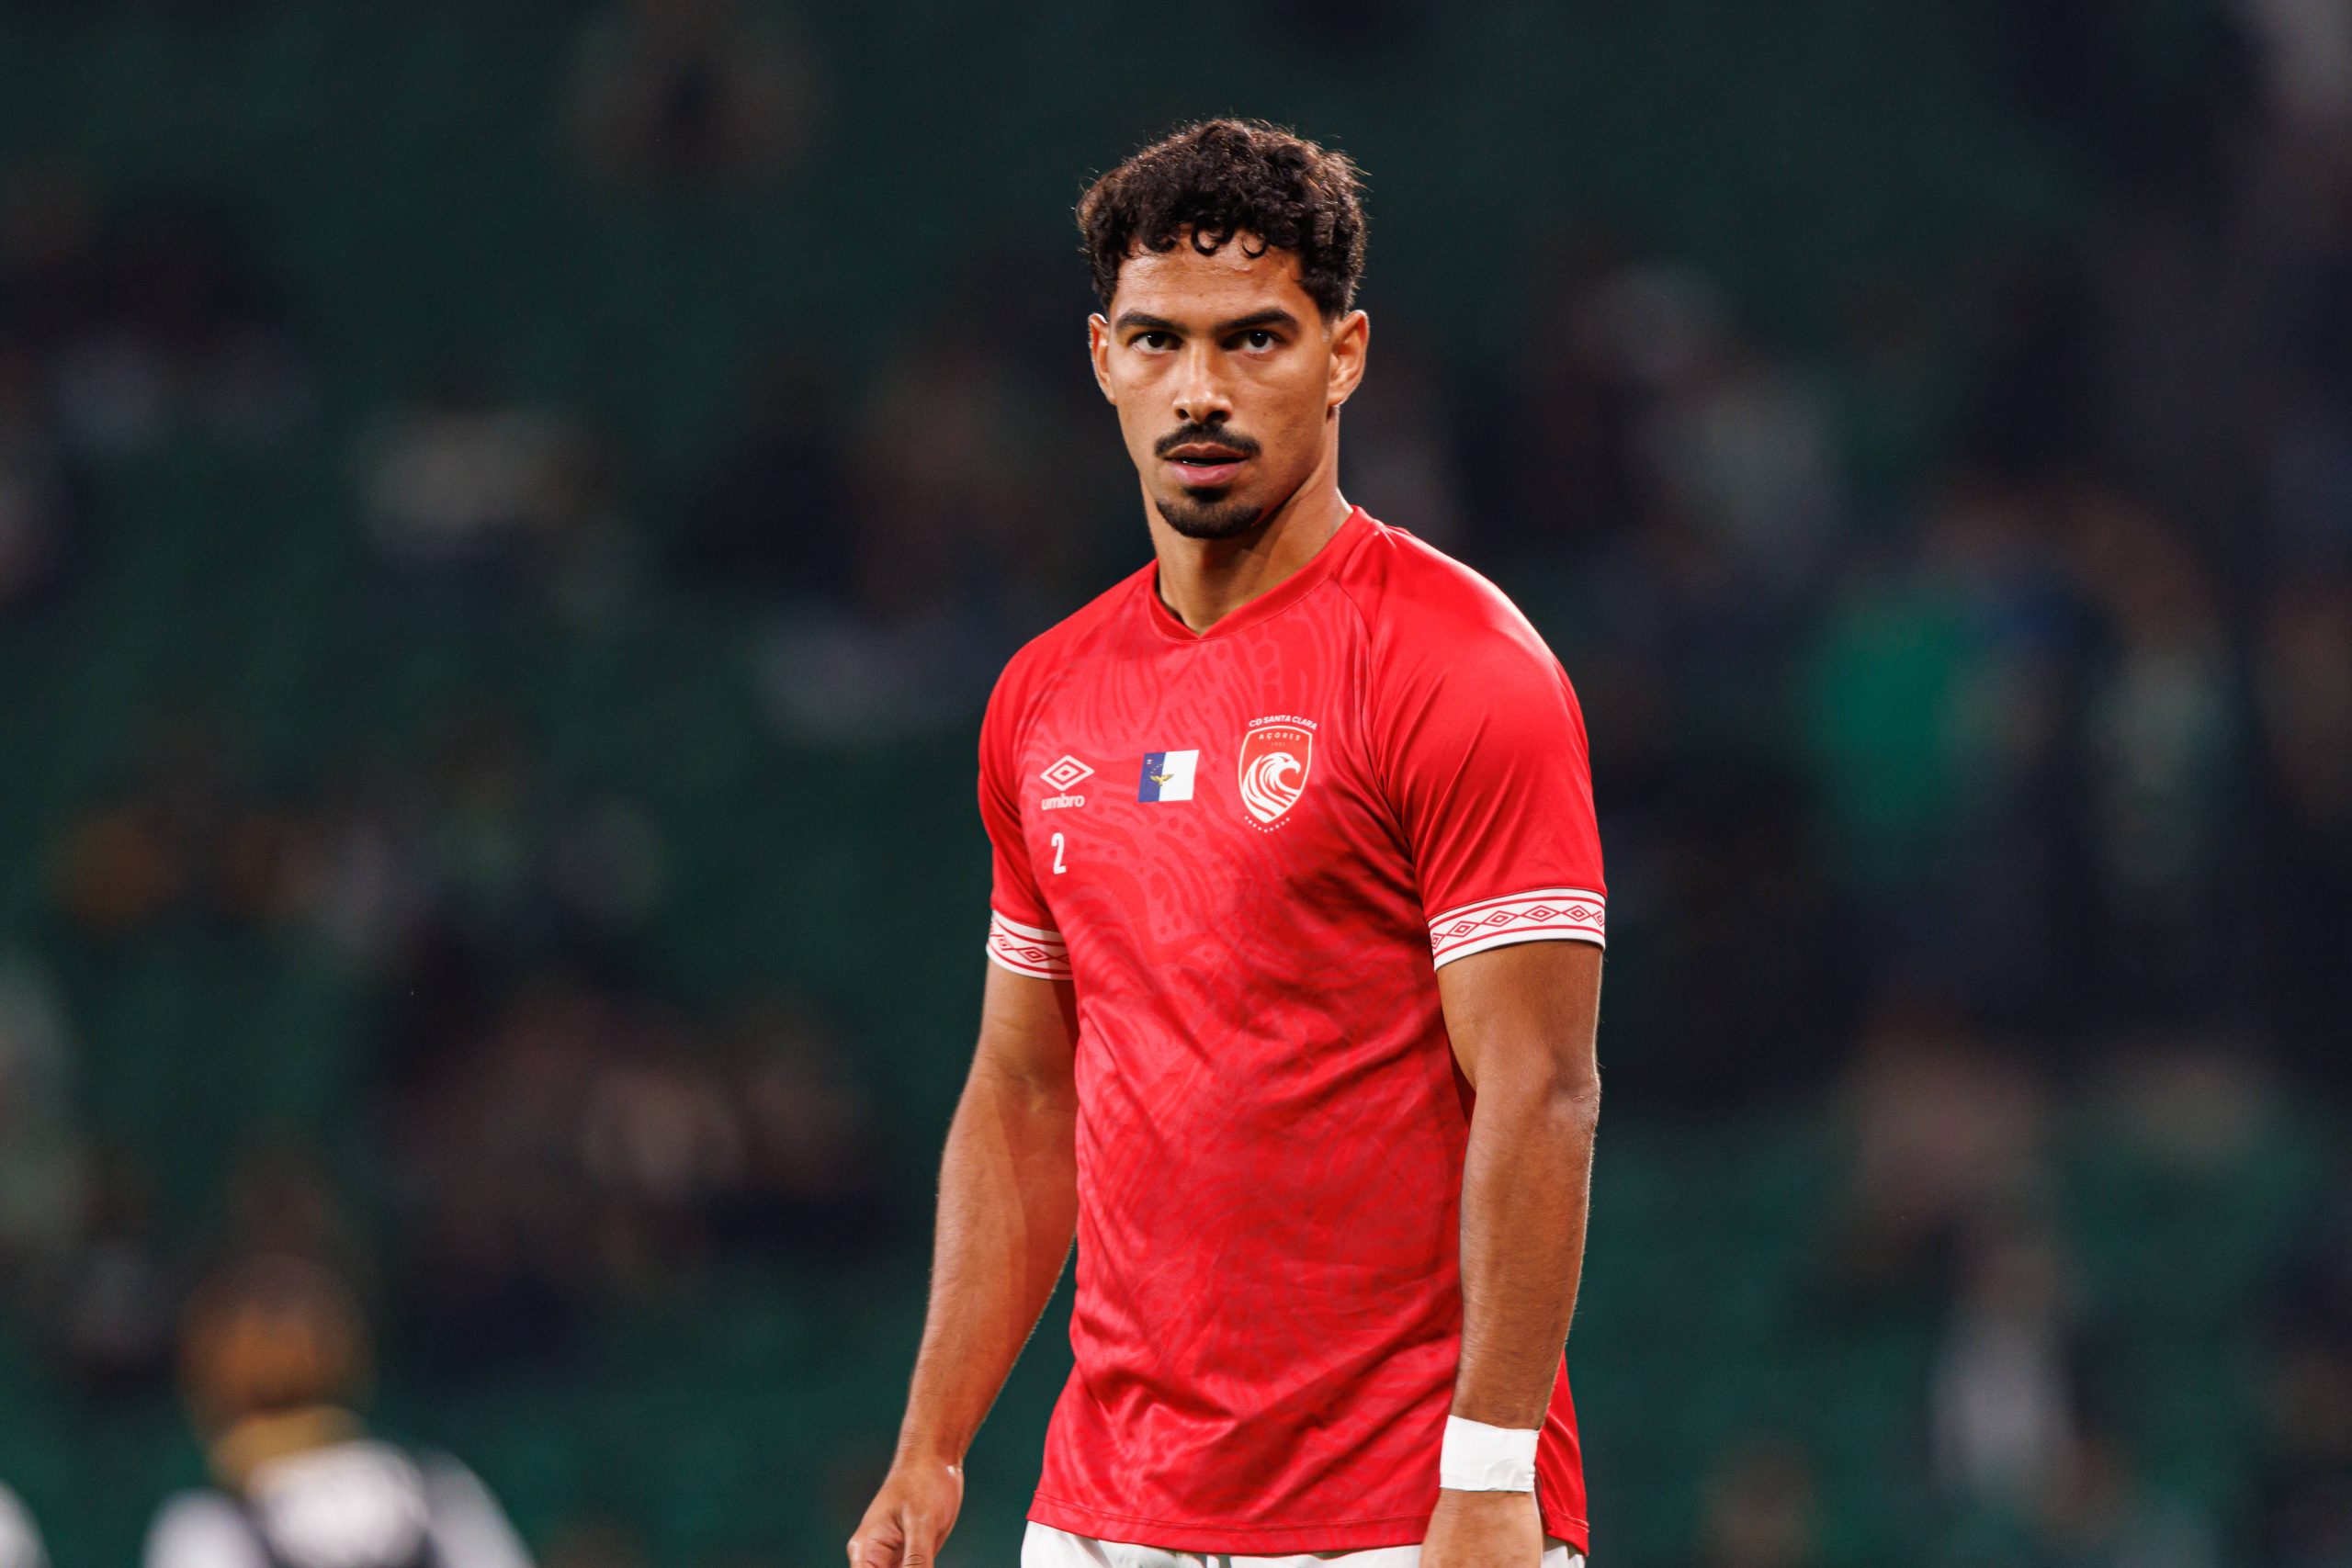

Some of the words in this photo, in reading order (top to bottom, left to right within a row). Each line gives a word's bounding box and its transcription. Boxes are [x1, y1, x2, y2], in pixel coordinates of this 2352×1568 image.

[1249, 717, 1262, 728] CD
[1263, 715, 1291, 724] SANTA
[1292, 716, 1317, 730] CLARA
[1041, 793, 1085, 810] umbro
[1051, 832, 1067, 874] 2
